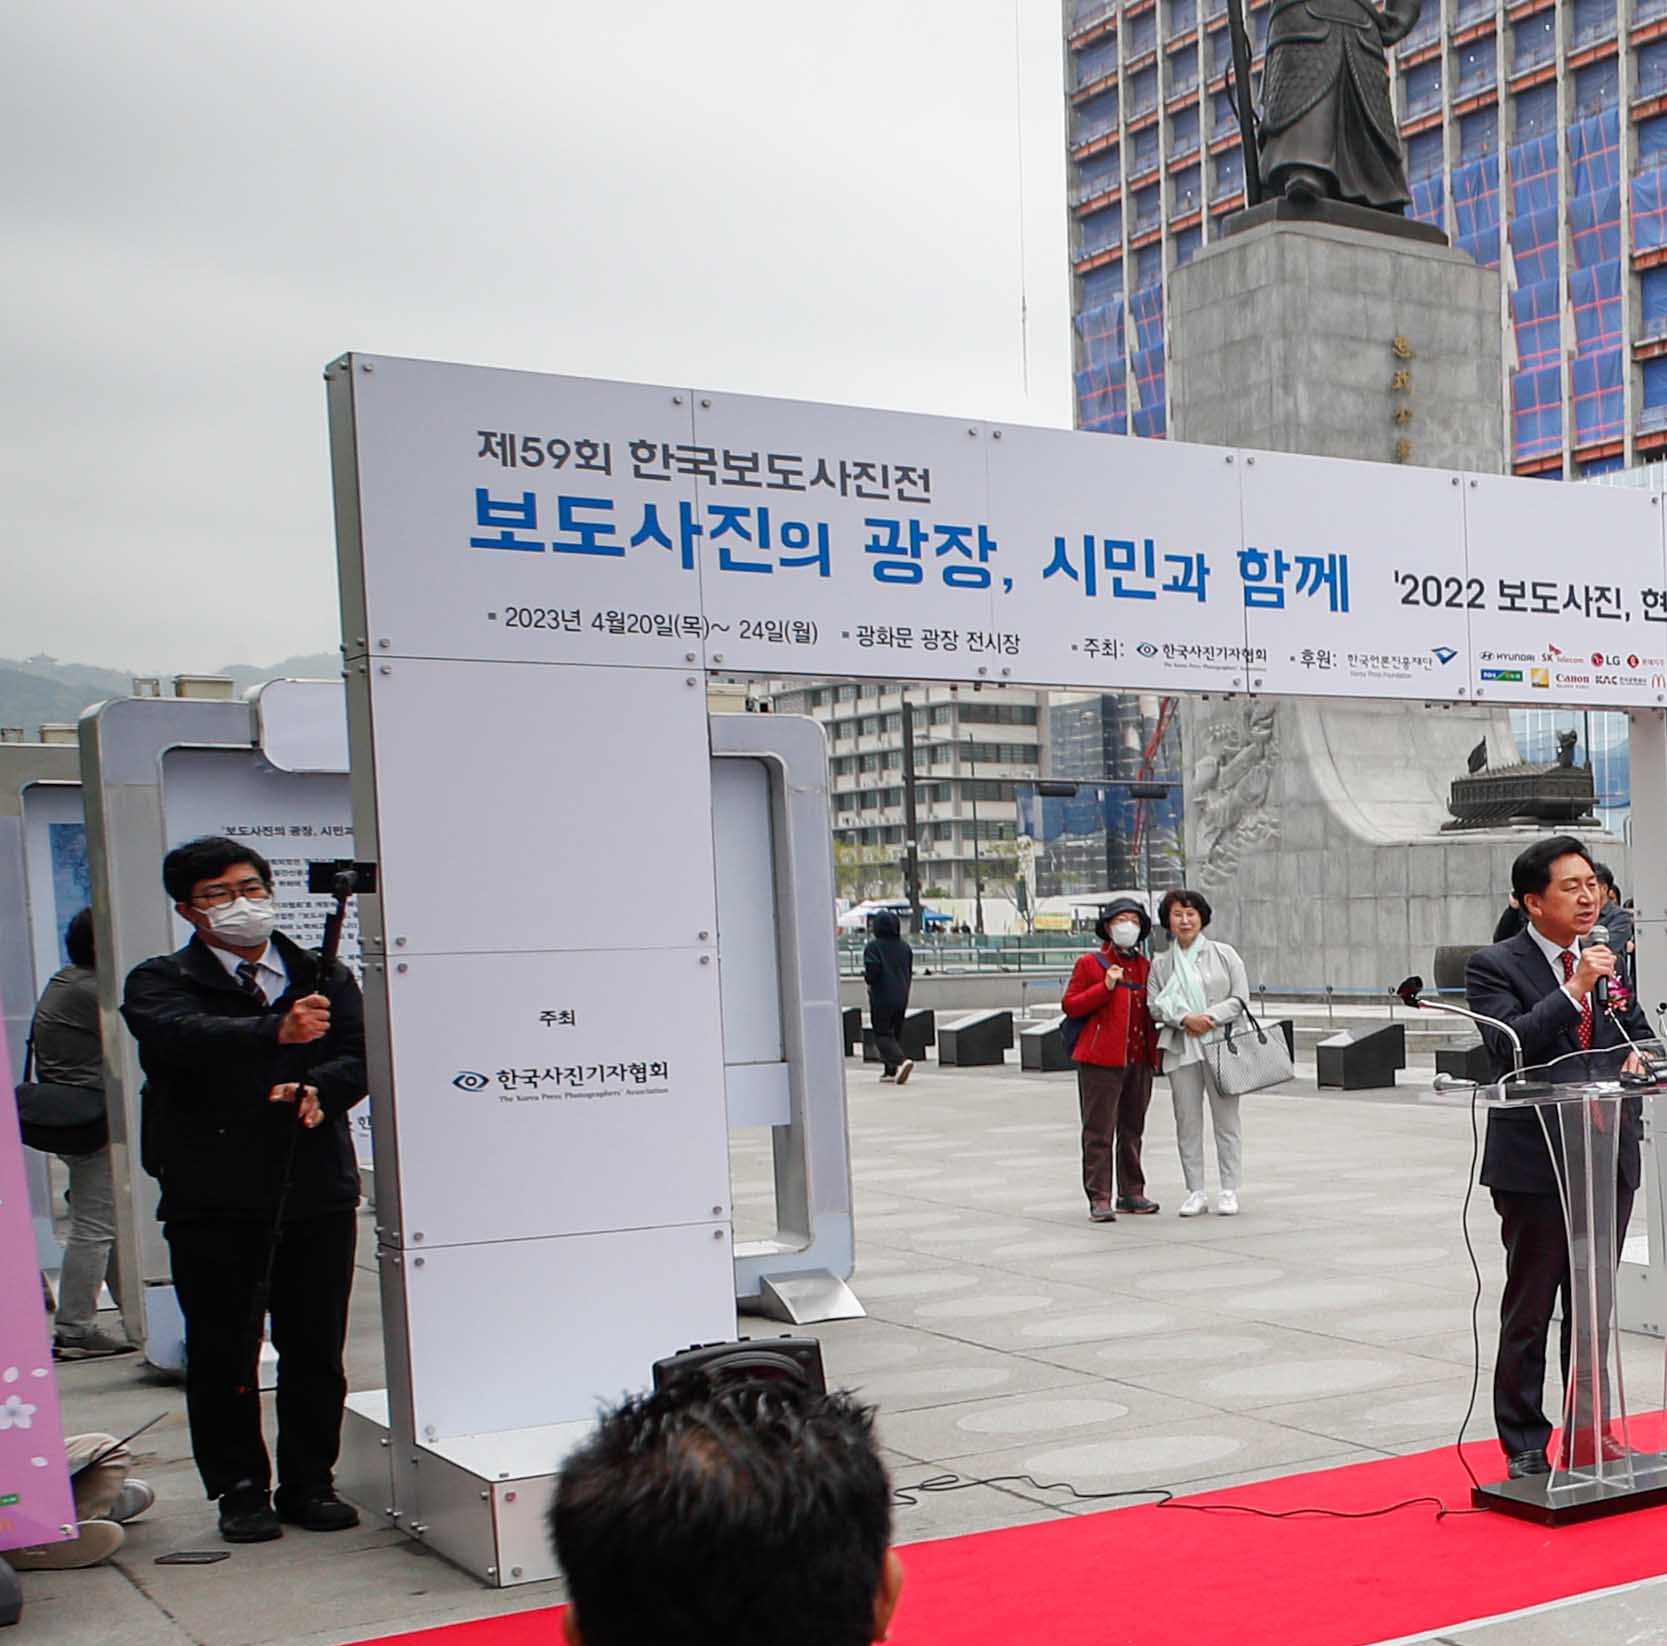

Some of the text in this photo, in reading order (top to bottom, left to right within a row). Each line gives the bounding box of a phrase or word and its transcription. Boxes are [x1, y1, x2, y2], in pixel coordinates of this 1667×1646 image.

[476, 430, 932, 504] 제59회 한국보도사진전
[470, 487, 1350, 613] 보도사진의 광장, 시민과 함께
[1394, 570, 1486, 609] '2022
[1498, 579, 1631, 623] 보도사진,
[504, 607, 582, 633] 2023년
[739, 619, 819, 645] 24일(월)
[856, 625, 1021, 656] 광화문 광장 전시장
[1083, 637, 1268, 664] 주최: 한국사진기자협회
[1299, 648, 1434, 672] 후원: 한국언론진흥재단
[1496, 653, 1536, 662] HYUNDAI
[1541, 653, 1553, 663] SK
[1606, 656, 1621, 666] LG
[1556, 673, 1590, 684] Canon
[539, 1009, 576, 1027] 주최
[496, 1060, 669, 1091] 한국사진기자협회
